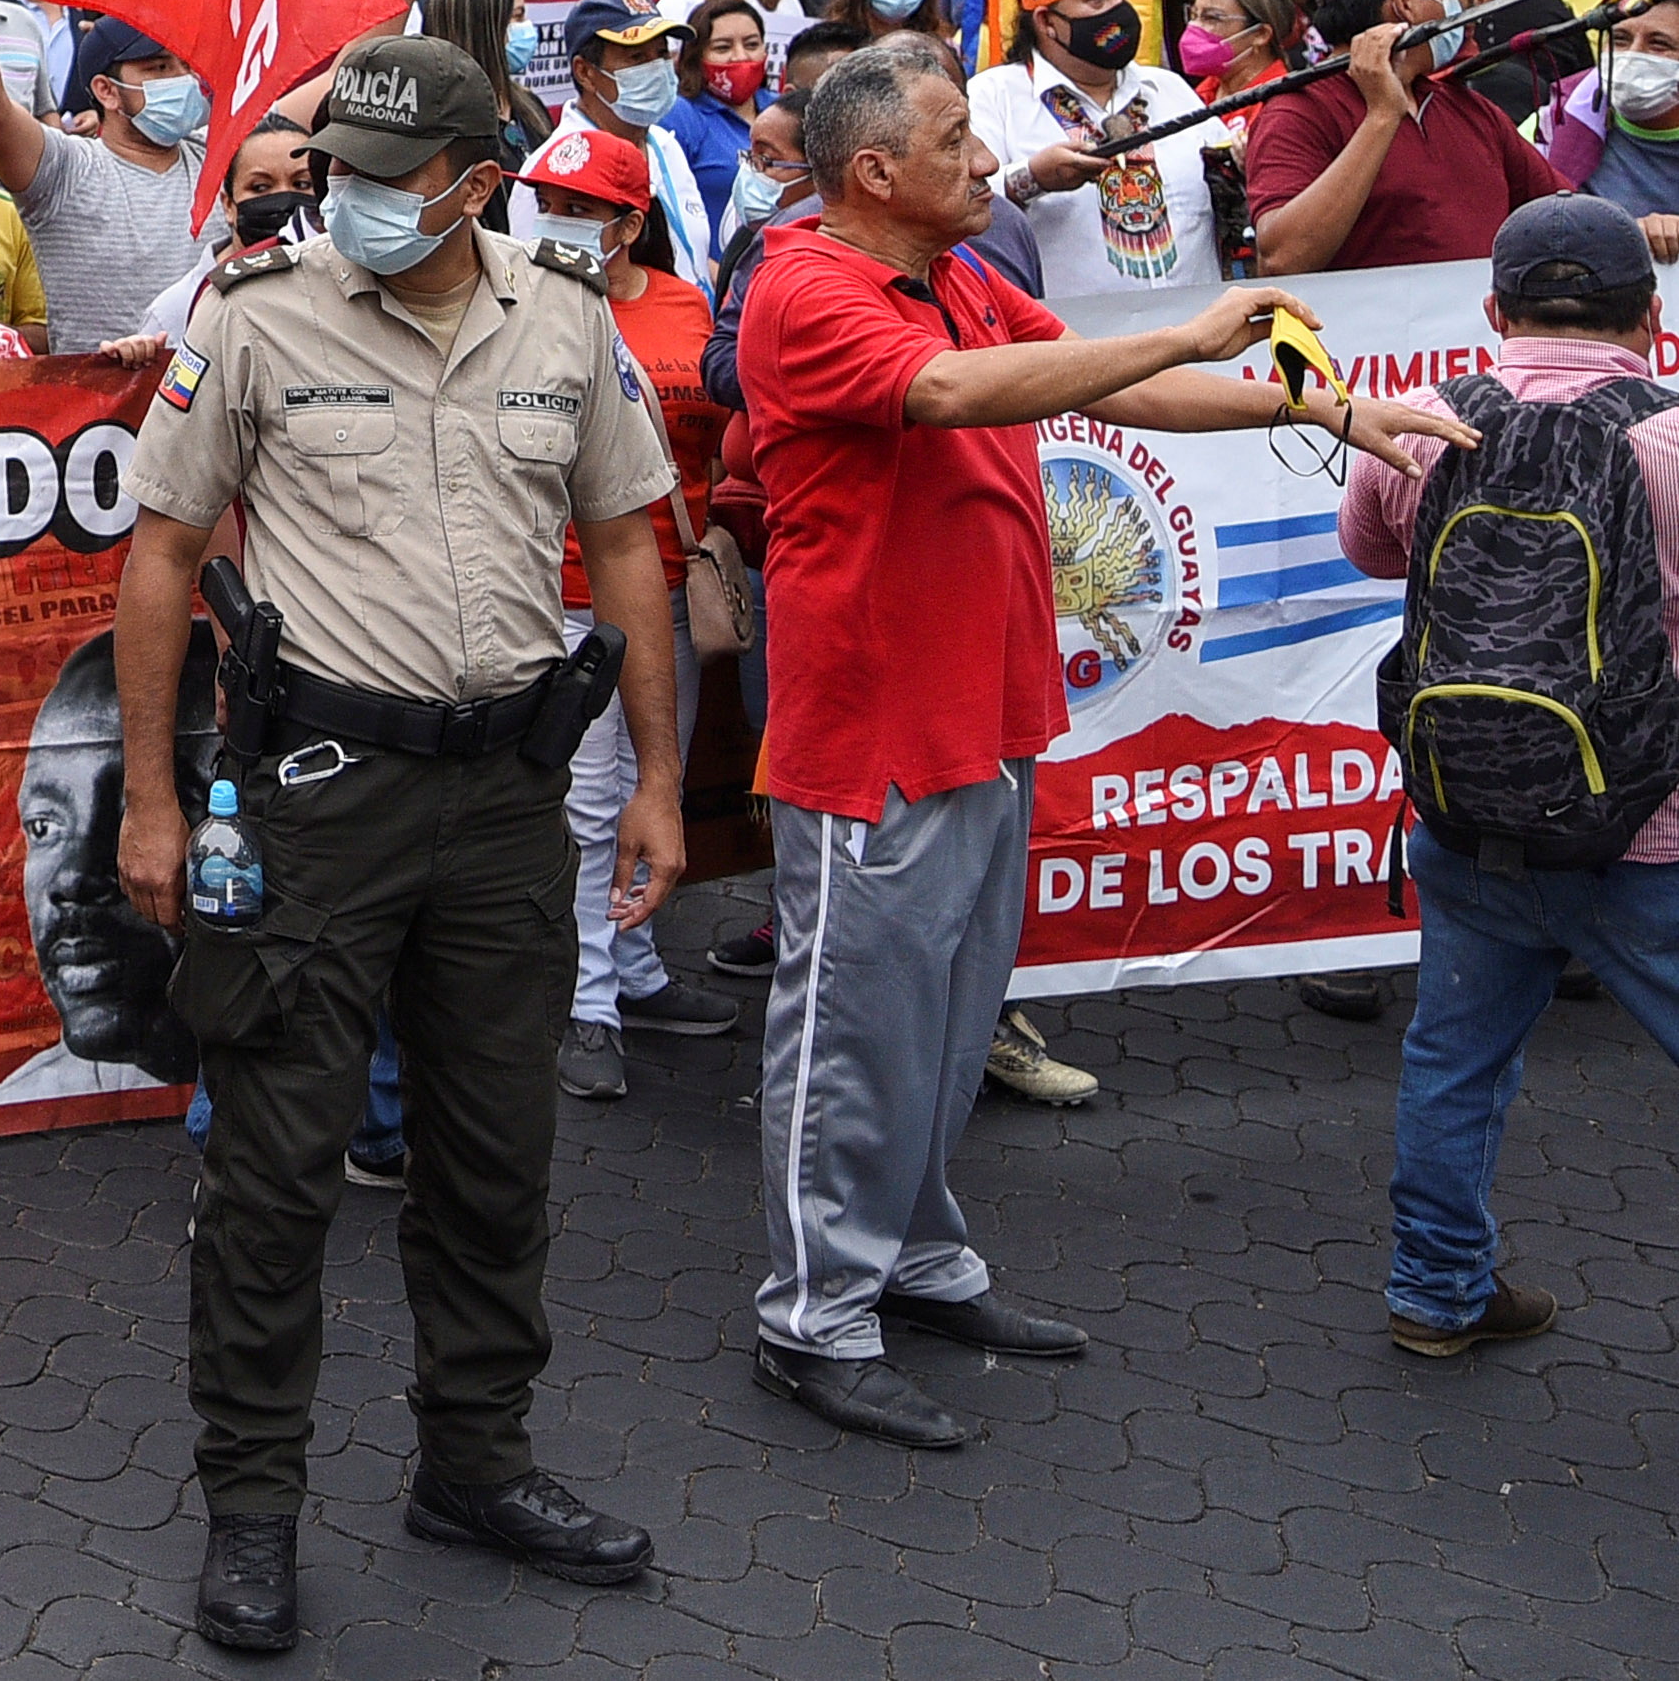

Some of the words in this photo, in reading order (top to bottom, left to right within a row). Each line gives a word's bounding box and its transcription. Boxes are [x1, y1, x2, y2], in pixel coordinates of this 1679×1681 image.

[332, 66, 418, 113] POLICÍA
[345, 102, 416, 126] NACIONAL
[179, 347, 202, 373] ADOR
[501, 393, 575, 414] POLICIA
[1035, 415, 1124, 459] IGENA
[1128, 441, 1176, 506] DEL
[1166, 504, 1203, 654] GUAYAS
[1064, 649, 1103, 689] G
[1037, 852, 1127, 915] DE
[1147, 836, 1273, 906] LOS
